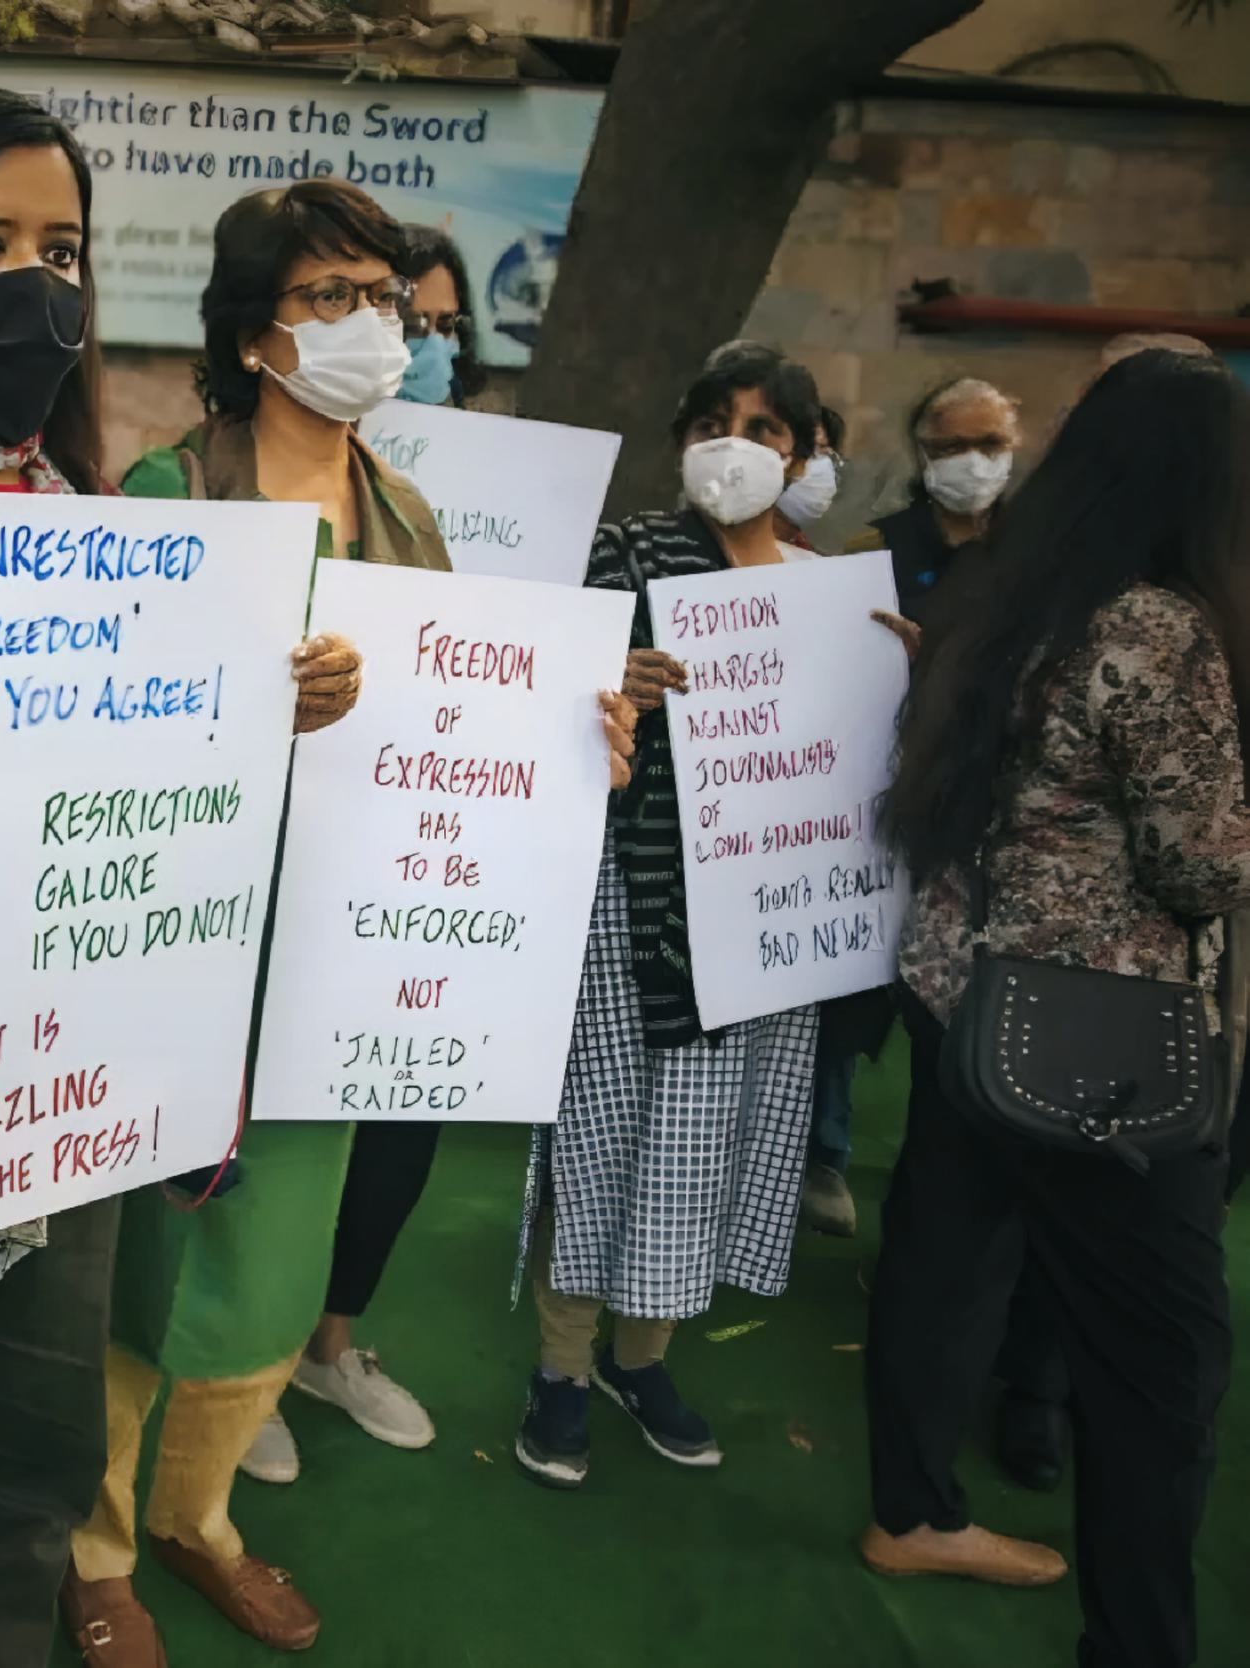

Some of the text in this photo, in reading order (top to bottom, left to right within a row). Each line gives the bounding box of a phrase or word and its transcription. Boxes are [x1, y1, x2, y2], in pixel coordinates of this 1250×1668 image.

[47, 87, 488, 143] ightier than the Sword
[126, 140, 216, 178] have
[228, 149, 334, 180] made
[347, 150, 436, 188] both
[672, 592, 780, 639] SEDITION
[415, 620, 535, 691] FREEDOM
[693, 649, 784, 692] HARGES
[5, 675, 78, 730] YOU
[93, 664, 223, 742] AGREE!
[435, 704, 462, 734] OF
[687, 699, 780, 742] AGAINST
[374, 743, 535, 799] EXPRESSION
[42, 779, 241, 845] RESTRICTIONS
[419, 811, 462, 843] HAS
[700, 800, 721, 829] OF
[35, 852, 158, 912] GALORE
[395, 852, 480, 887] TO BE
[33, 885, 253, 970] IF YOU DO NOT!
[760, 931, 799, 972] BAD
[397, 977, 448, 1009] NOT
[34, 1008, 60, 1053] IS
[394, 1070, 415, 1080] OR
[53, 1105, 159, 1183] PRESS!
